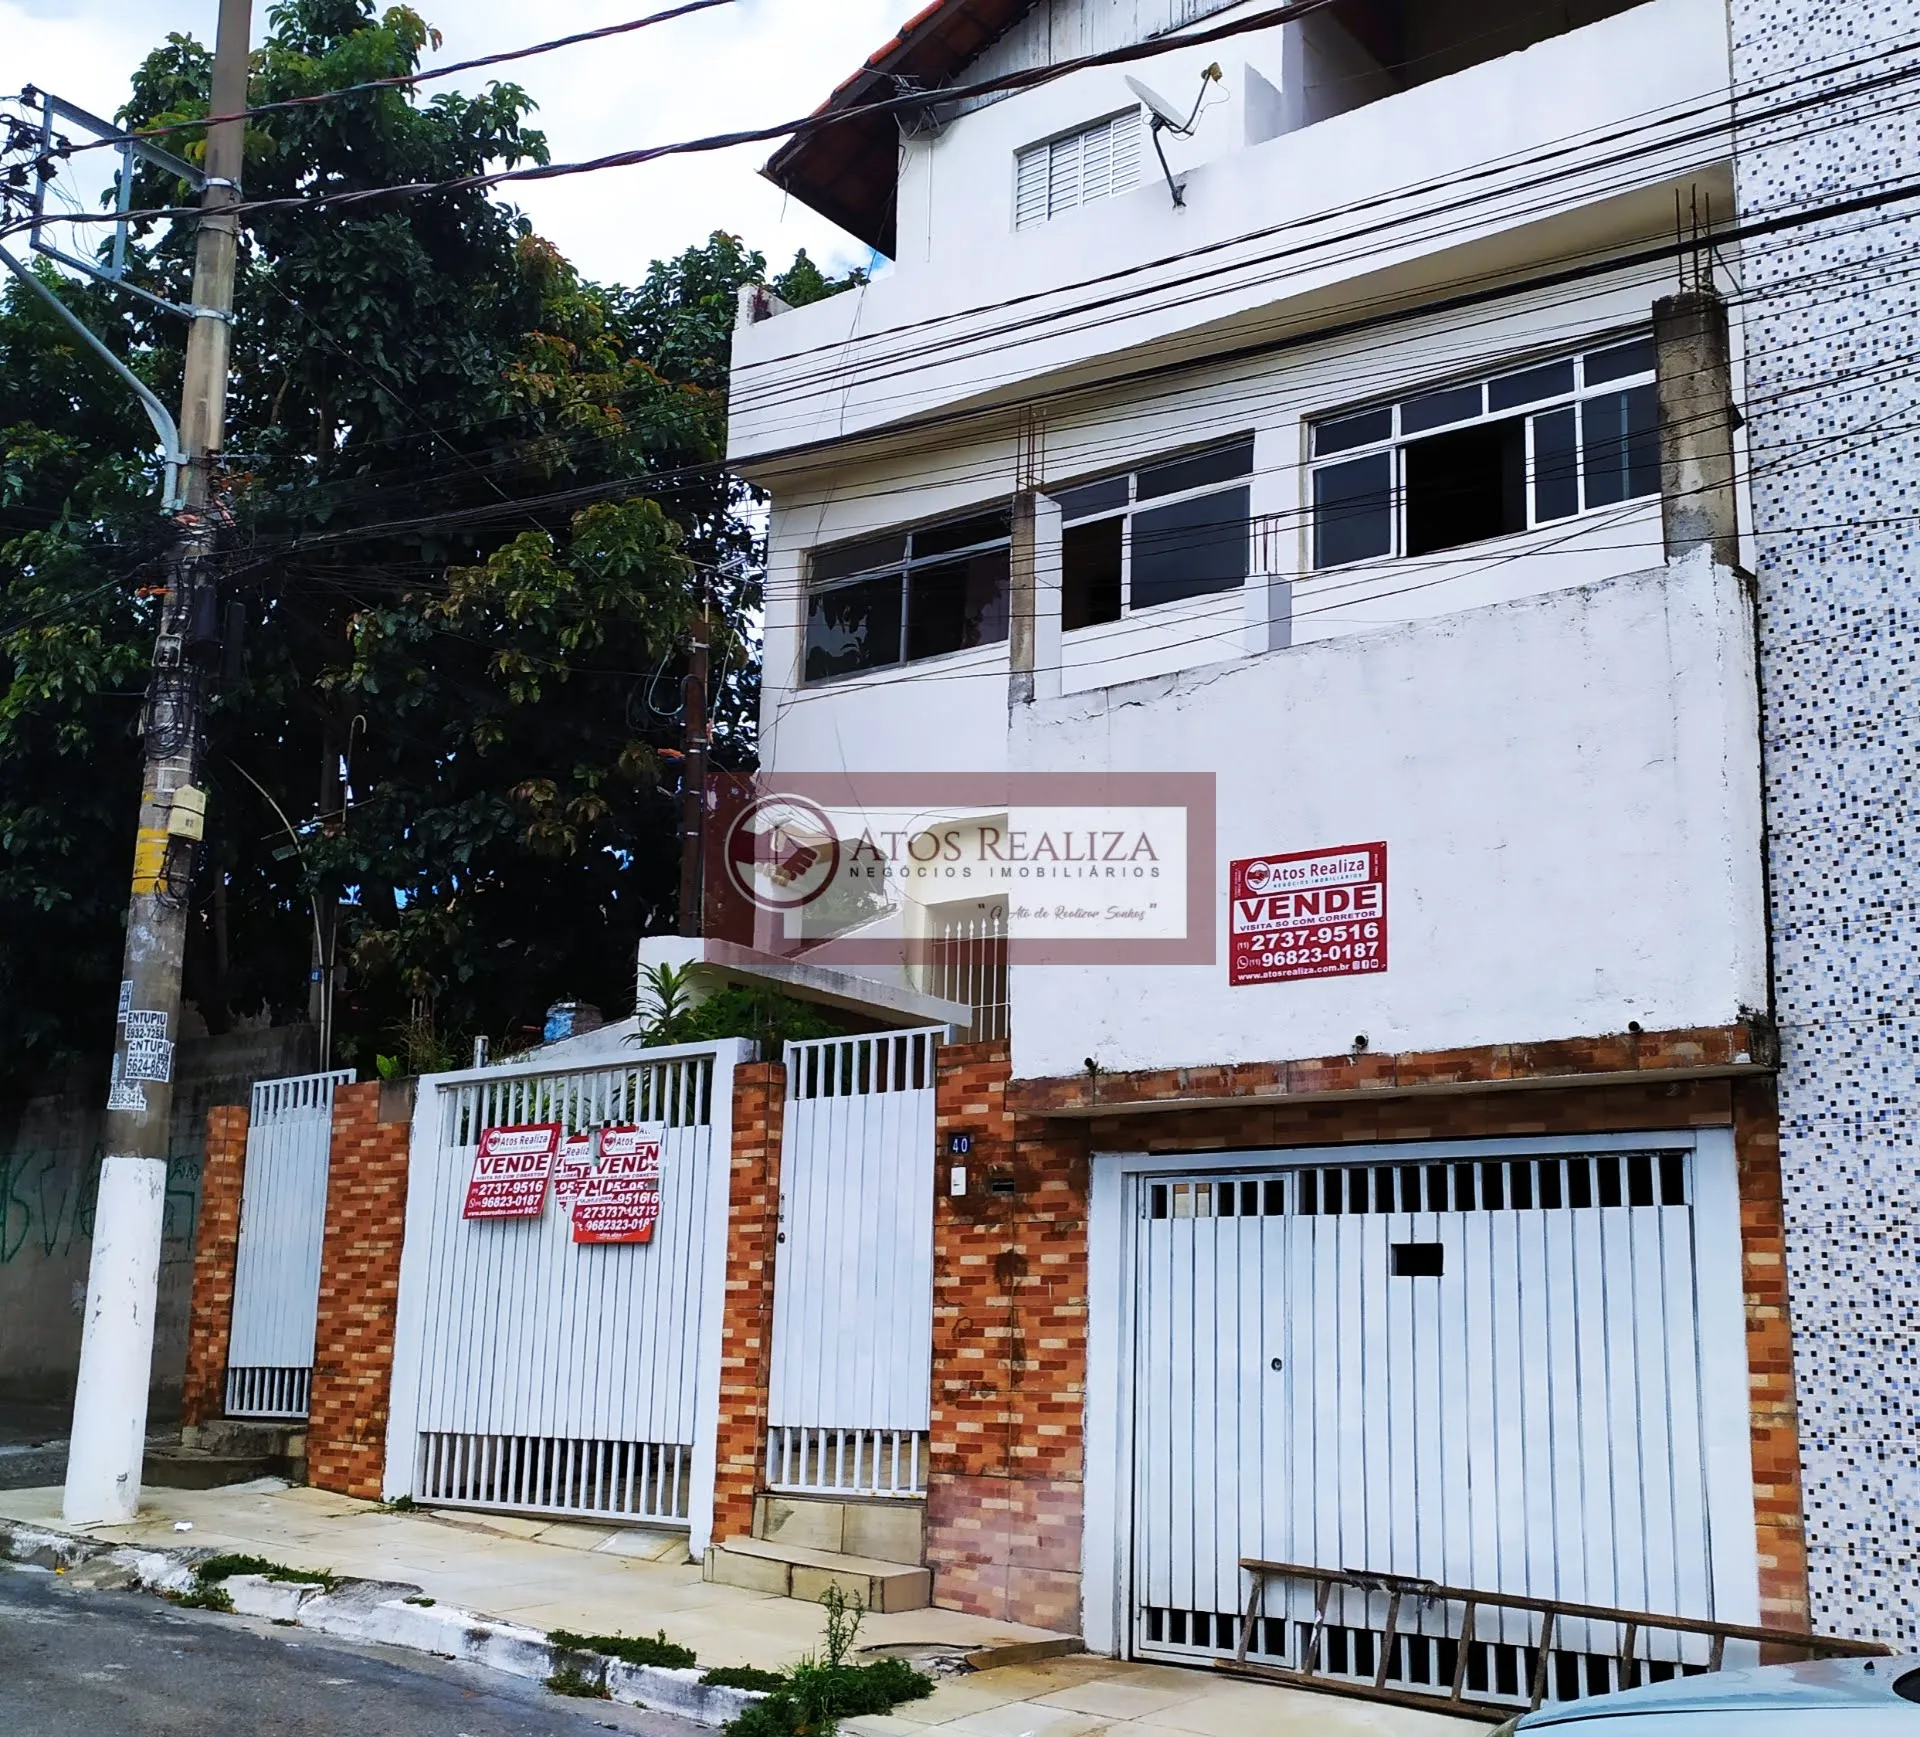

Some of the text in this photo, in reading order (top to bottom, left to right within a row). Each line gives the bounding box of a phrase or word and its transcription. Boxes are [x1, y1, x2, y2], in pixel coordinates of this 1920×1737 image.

[1272, 868, 1305, 882] Atos
[1310, 859, 1365, 877] Realiza
[1239, 885, 1377, 923] VENDE
[1240, 922, 1272, 932] VISITA
[1292, 917, 1316, 926] COM
[1318, 910, 1376, 923] CORRETOR
[1251, 922, 1379, 951] 2737-9516
[1261, 941, 1379, 967] 96823-0187
[1238, 959, 1350, 981] www.atosrealiza.com.br
[128, 1012, 166, 1025] ENTUPIU
[500, 1137, 518, 1146] Atos
[520, 1133, 548, 1145] Realiza
[952, 1138, 968, 1152] 40
[480, 1155, 550, 1175] VENDE
[478, 1181, 544, 1196] 2737-9516
[481, 1195, 542, 1208] 96823-0187
